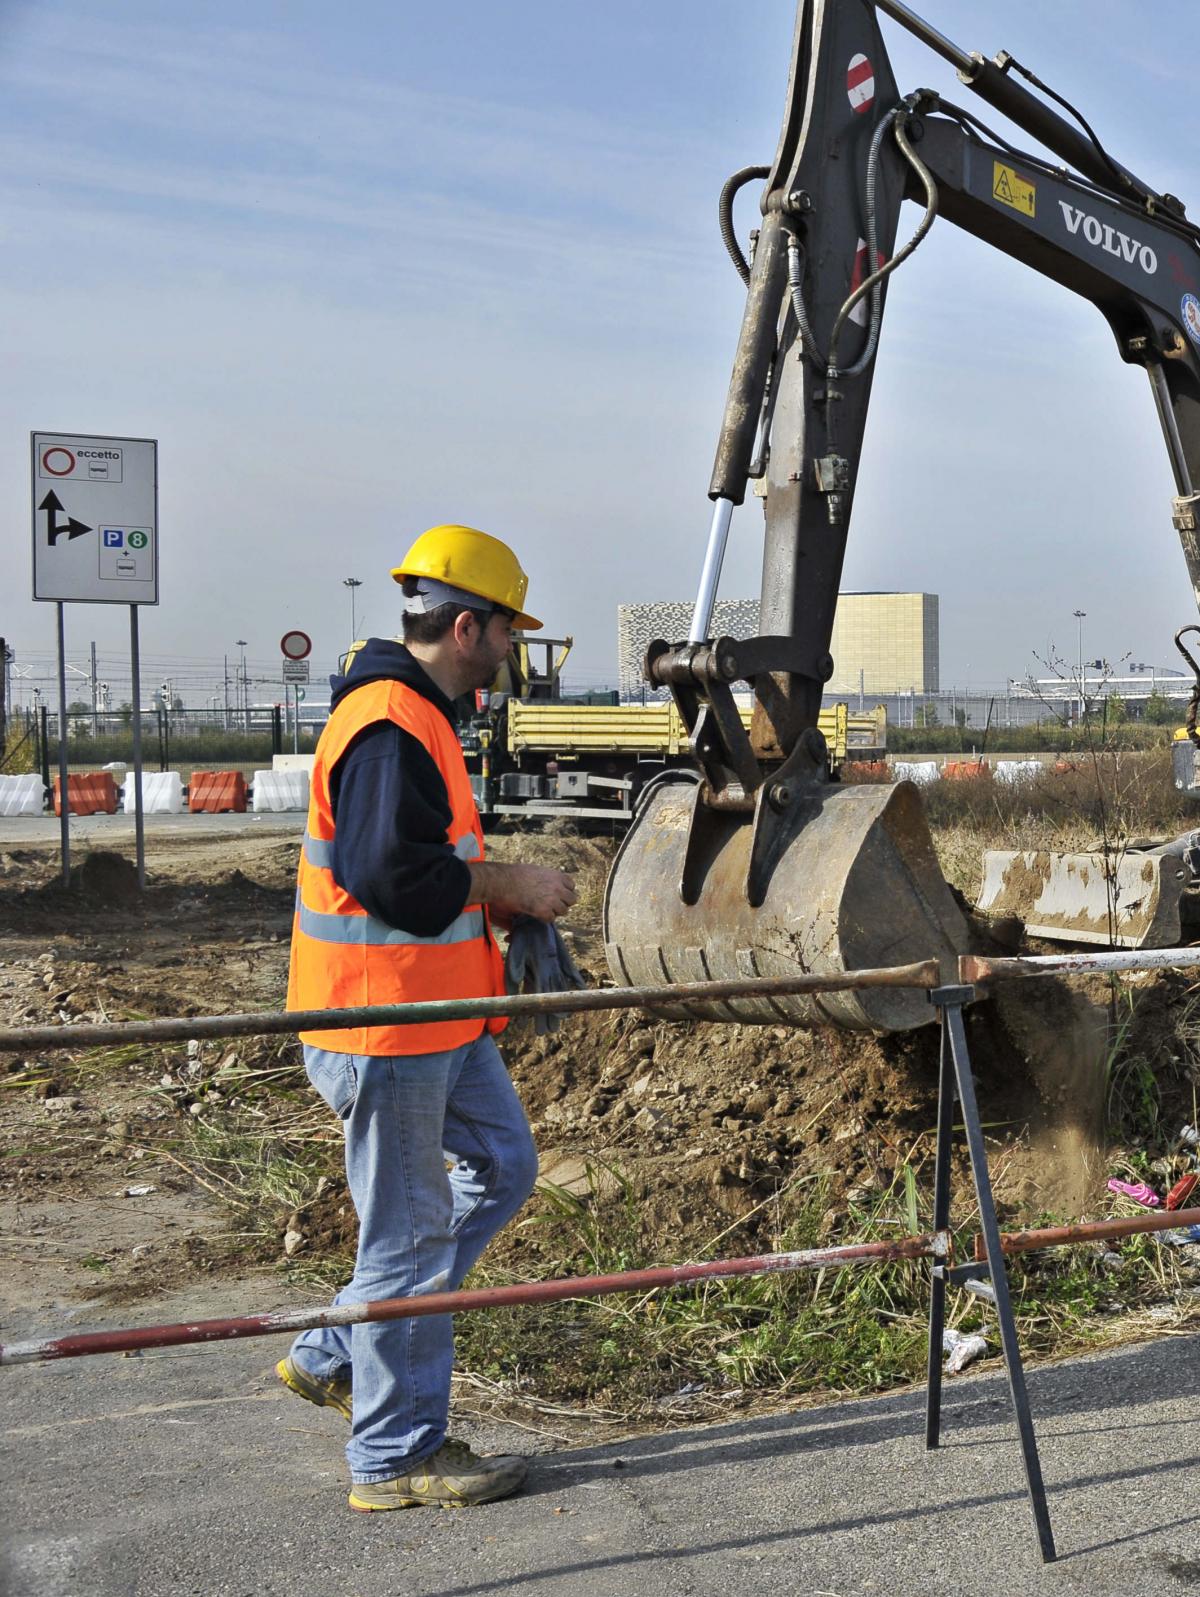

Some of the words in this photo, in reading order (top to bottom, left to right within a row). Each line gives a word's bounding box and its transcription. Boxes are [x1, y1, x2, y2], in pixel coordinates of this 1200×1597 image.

[1058, 200, 1158, 275] VOLVO
[76, 449, 120, 461] eccetto
[106, 531, 120, 546] P
[131, 532, 145, 548] 8
